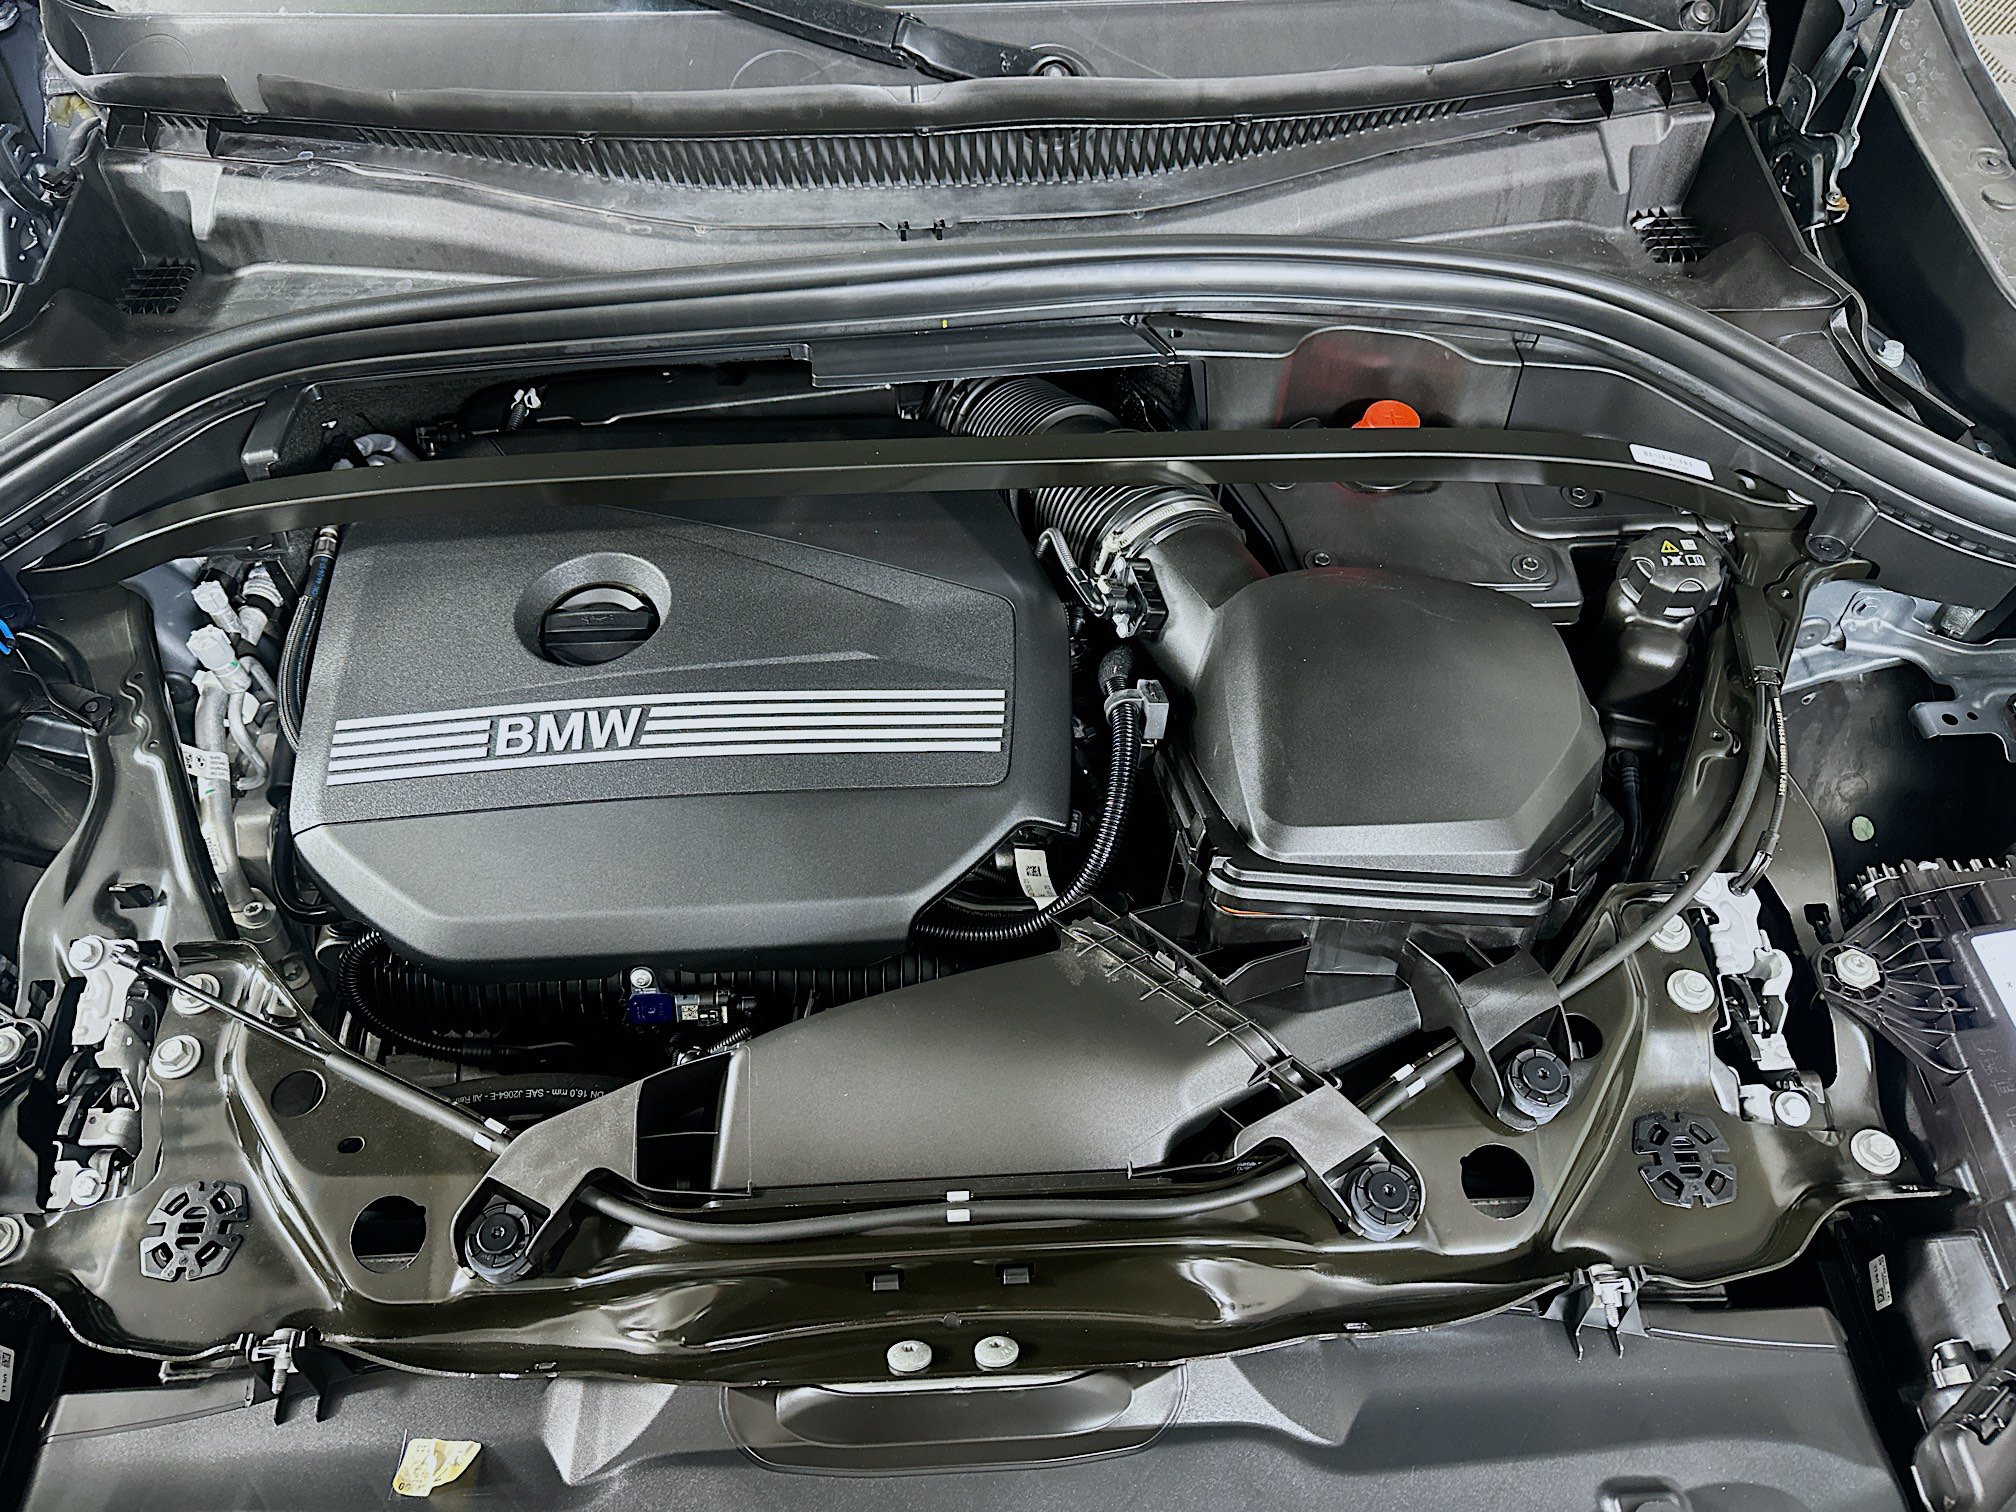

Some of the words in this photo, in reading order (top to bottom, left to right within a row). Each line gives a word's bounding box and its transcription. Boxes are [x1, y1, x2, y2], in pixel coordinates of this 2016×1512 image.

[495, 707, 643, 756] BMW
[490, 1089, 523, 1101] J2064-E
[525, 1088, 544, 1098] SAE
[551, 1088, 568, 1096] mm
[590, 1090, 604, 1099] DN
[472, 1093, 483, 1103] All
